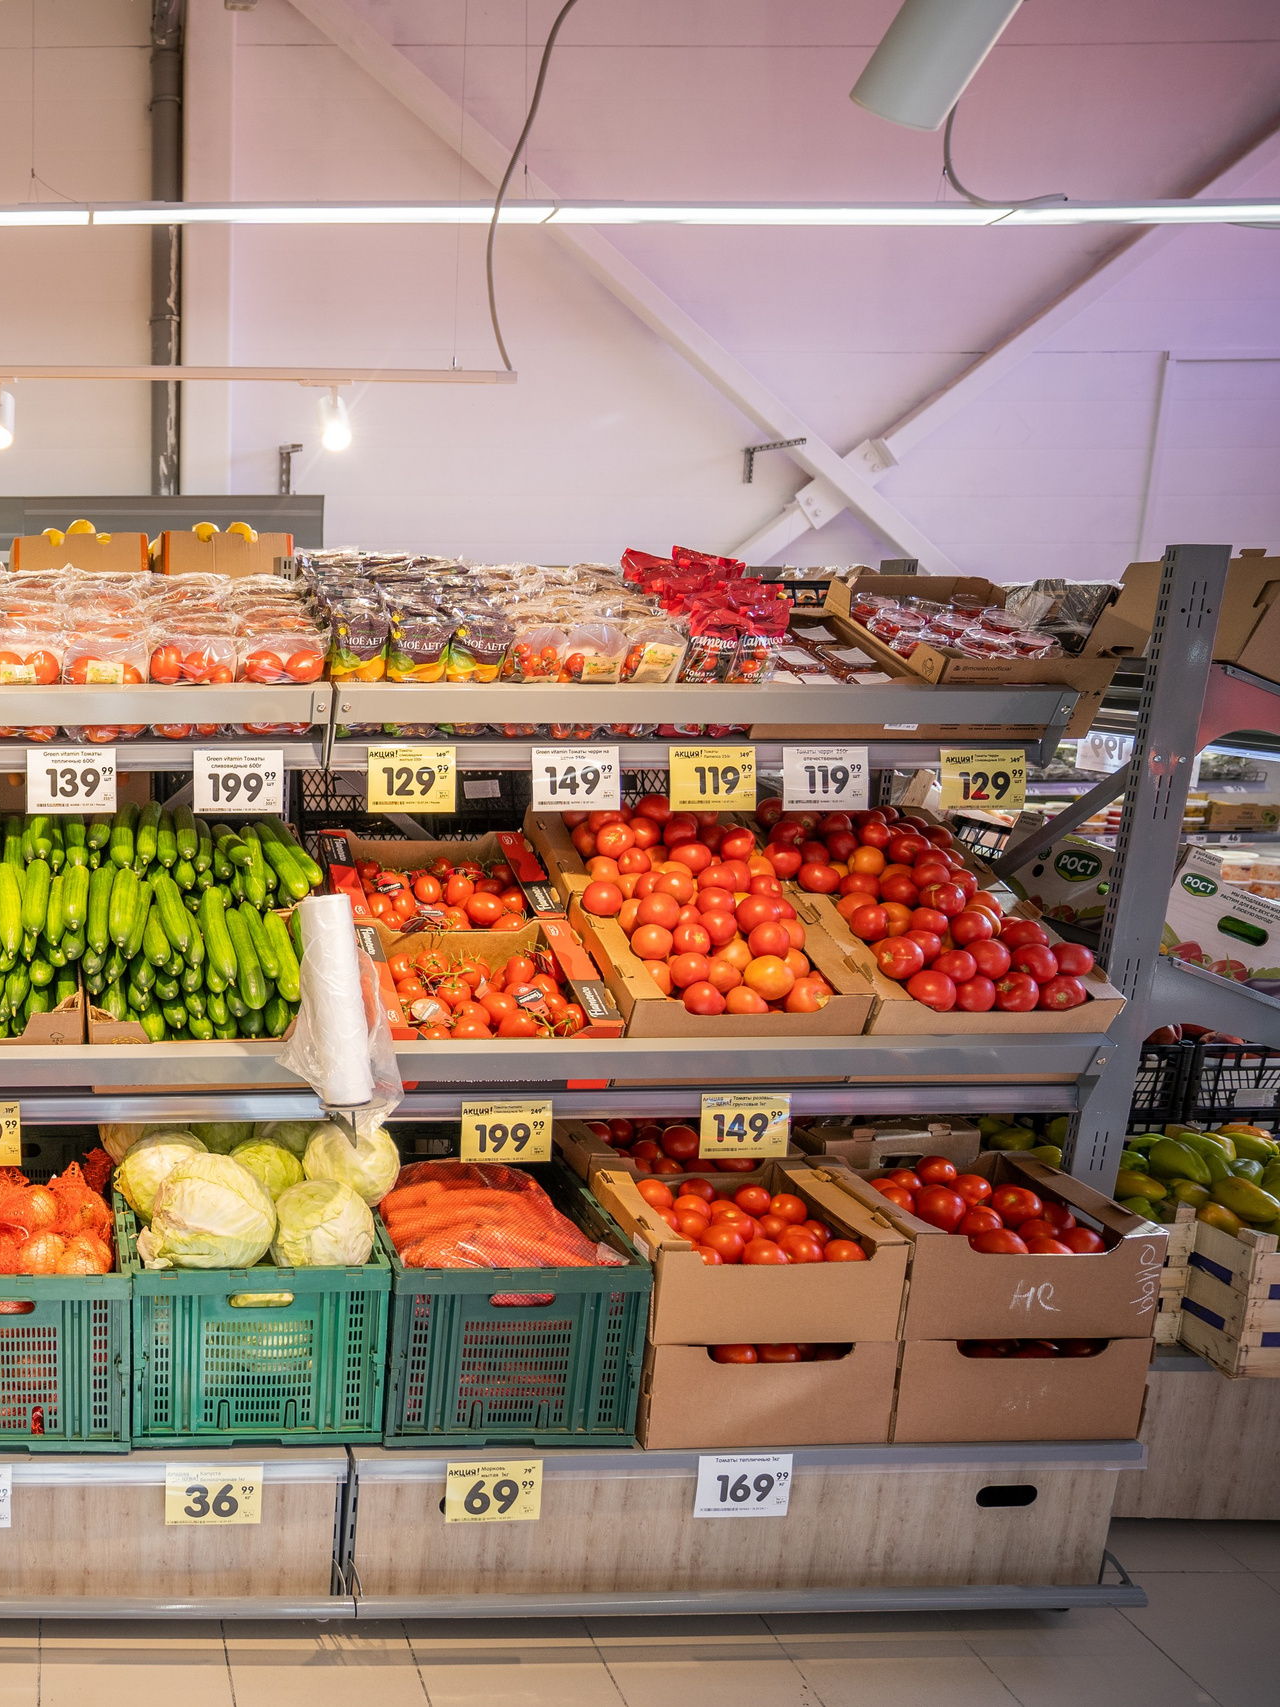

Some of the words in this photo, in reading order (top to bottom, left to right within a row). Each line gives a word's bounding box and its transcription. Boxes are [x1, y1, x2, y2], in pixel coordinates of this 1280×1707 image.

[346, 636, 365, 646] МОЁ
[398, 640, 420, 650] МОЁ
[462, 639, 483, 649] МОЁ
[369, 750, 398, 760] АКЦИЯ!
[674, 750, 703, 759] АКЦИЯ!
[946, 755, 974, 764] АКЦИЯ!
[46, 768, 100, 798] 139
[101, 767, 114, 775] 99
[208, 773, 263, 803] 199
[264, 772, 276, 780] 99
[382, 767, 436, 796] 129
[545, 766, 600, 795] 149
[601, 764, 613, 772] 99
[695, 766, 740, 795] 119
[741, 764, 753, 772] 99
[804, 765, 849, 794] 119
[850, 764, 862, 772] 99
[959, 771, 1010, 801] 129
[1012, 769, 1023, 778] 99
[1058, 854, 1098, 875] РОСТ
[1195, 850, 1222, 863] ВЫРАЩЕНО
[1197, 856, 1216, 866] РОССИИ
[1184, 875, 1215, 894] РОСТ
[581, 986, 605, 1018] Flamenco
[463, 1106, 493, 1116] АКЦИЯ!
[5, 1120, 17, 1129] 99
[475, 1123, 531, 1153] 199
[532, 1121, 545, 1129] 99
[713, 1113, 769, 1143] 149
[448, 1467, 480, 1477] АКЦИЯ!
[464, 1479, 519, 1515] 69
[522, 1480, 534, 1488] 99
[717, 1473, 775, 1502] 169
[776, 1472, 789, 1480] 99
[184, 1483, 239, 1518] 36
[241, 1486, 254, 1494] 99
